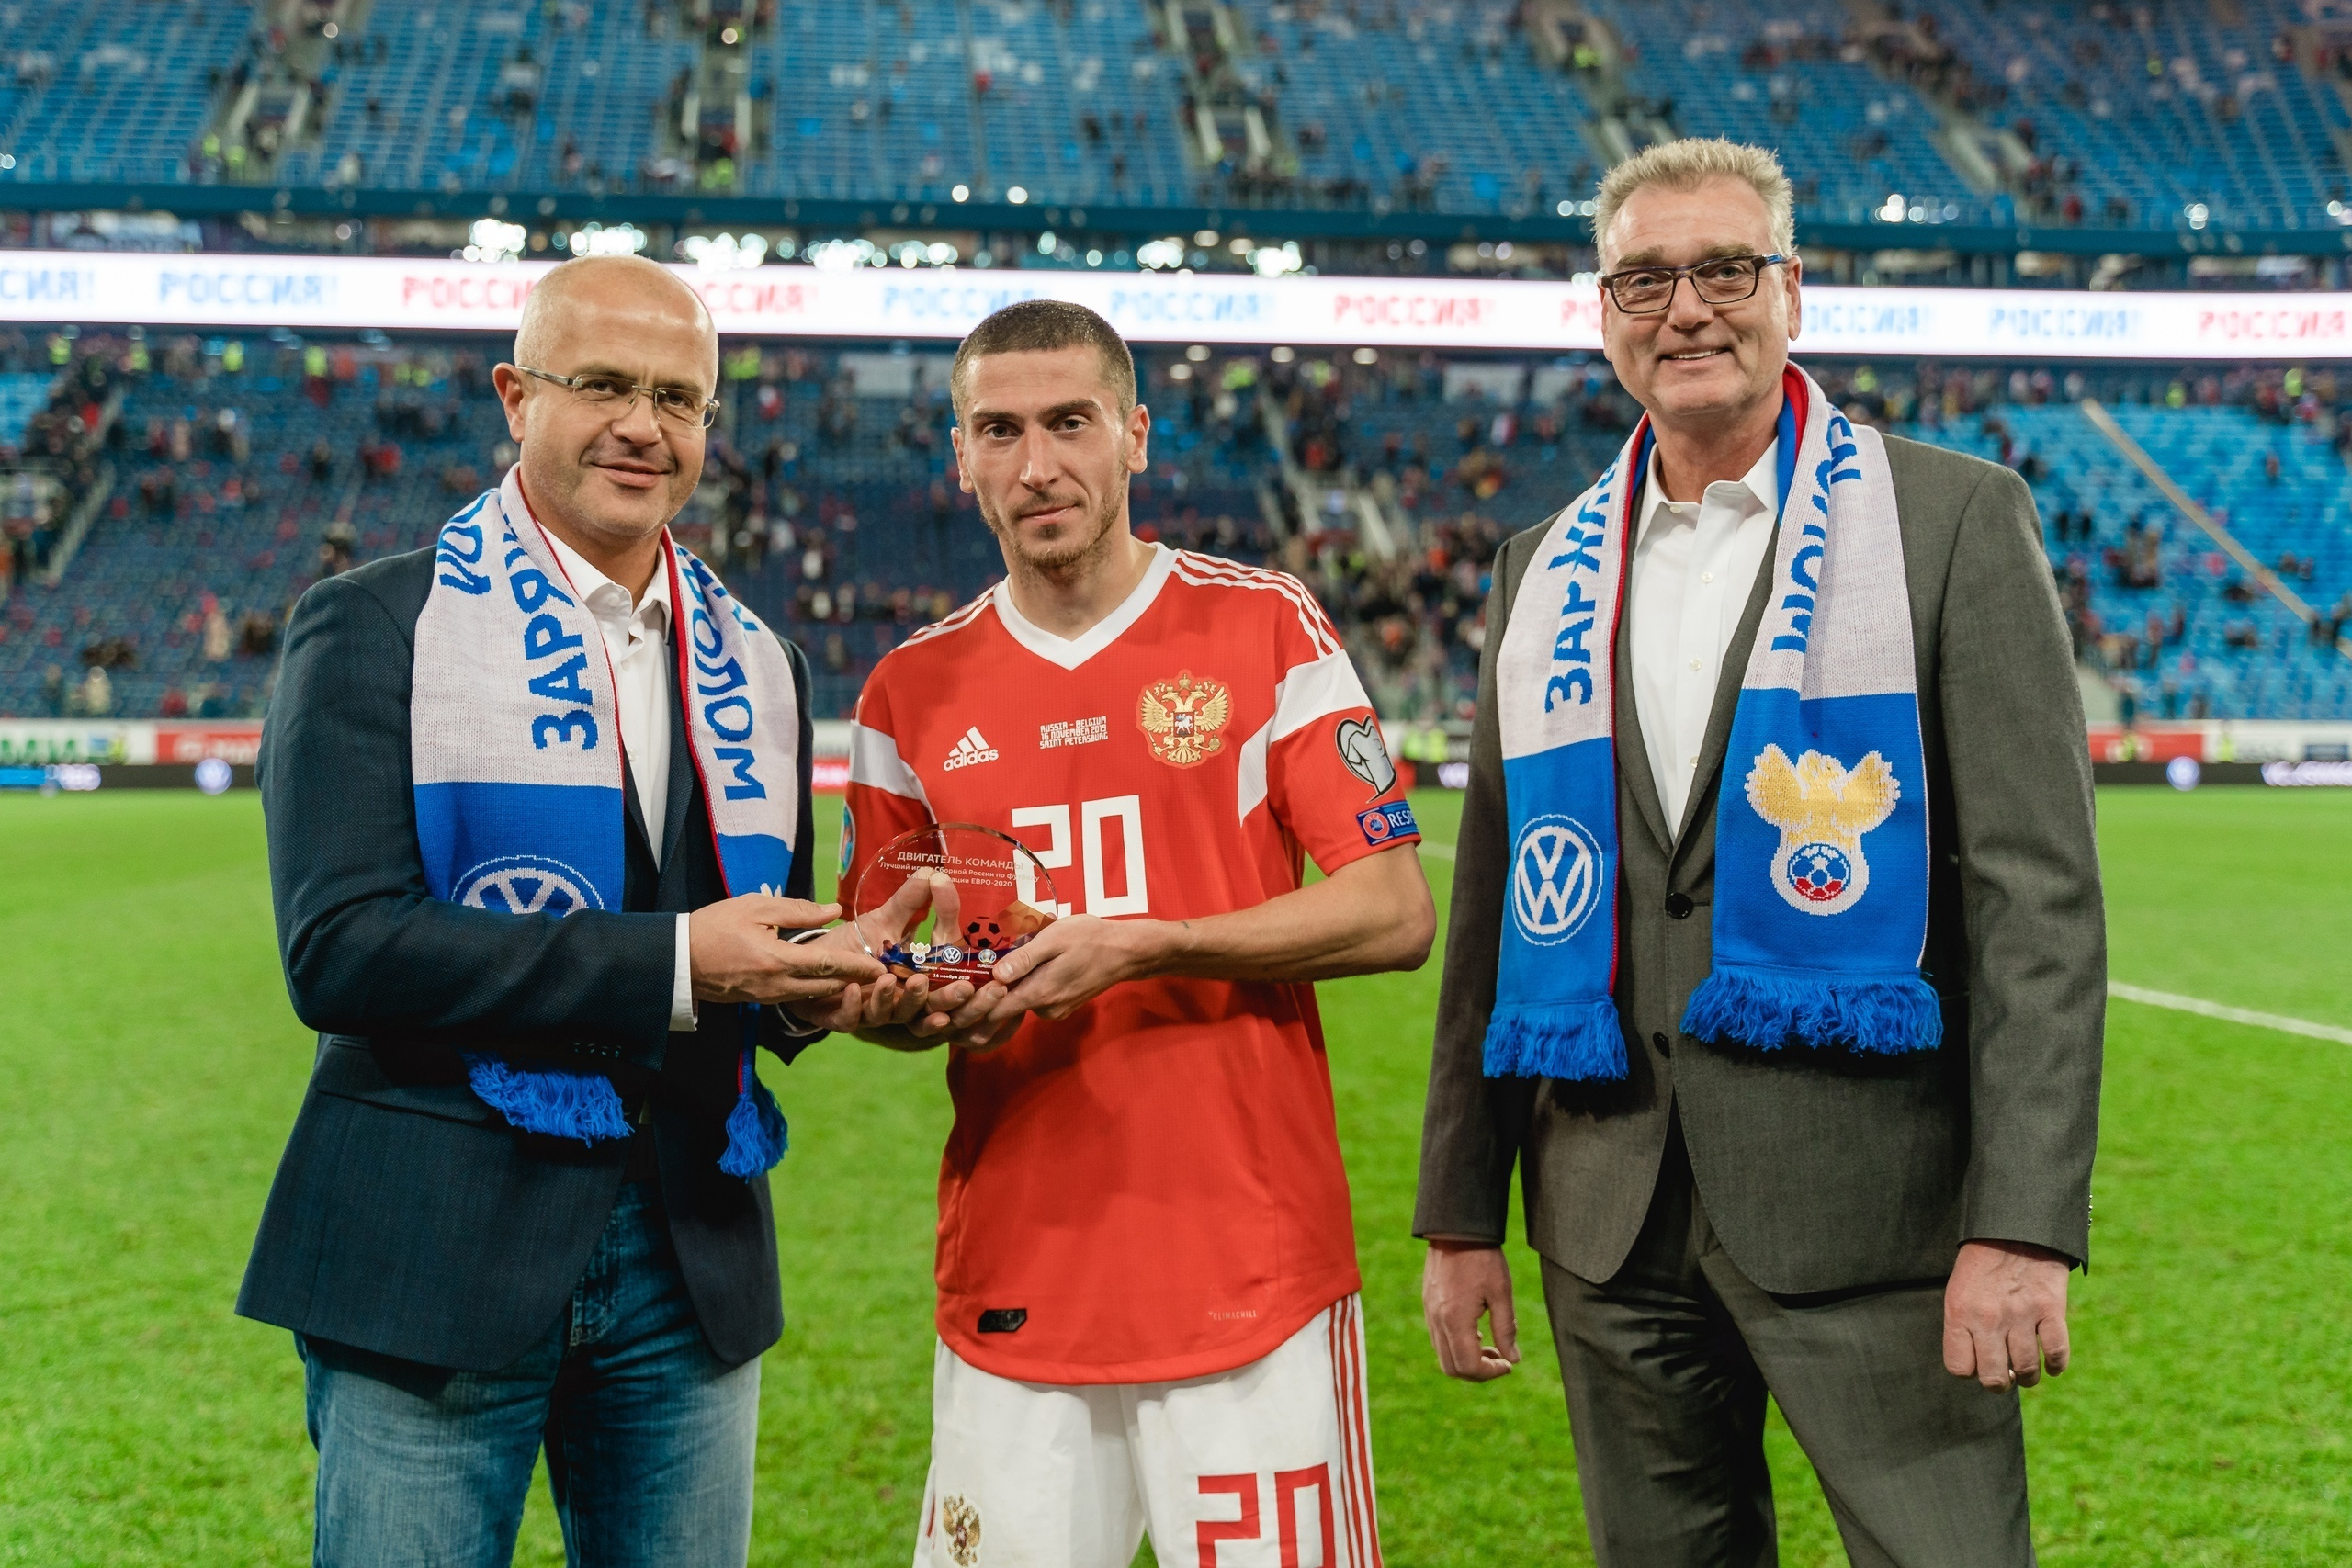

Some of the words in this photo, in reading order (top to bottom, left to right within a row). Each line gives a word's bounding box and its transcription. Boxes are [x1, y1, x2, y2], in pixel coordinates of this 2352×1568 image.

[1076, 716, 1107, 728] BELGIUM
[1039, 739, 1062, 750] SAINT
[1065, 732, 1109, 746] PETERSBURG
[1041, 733, 1049, 741] 16
[1051, 728, 1090, 739] NOVEMBER
[1091, 724, 1107, 734] 2019
[943, 748, 1000, 772] adidas
[1387, 810, 1417, 829] RESP
[897, 852, 963, 866] ДВИГАТЕЛЬ
[965, 857, 1023, 871] КОМАНДЫ
[1012, 795, 1148, 919] 20
[880, 862, 910, 871] Лучший
[934, 866, 967, 875] Сборной
[968, 869, 995, 877] России
[1007, 872, 1040, 883] футболу
[971, 877, 1012, 887] ЕВРО-2020
[1213, 1309, 1257, 1322] CLIMACHILL
[1196, 1462, 1336, 1568] 20
